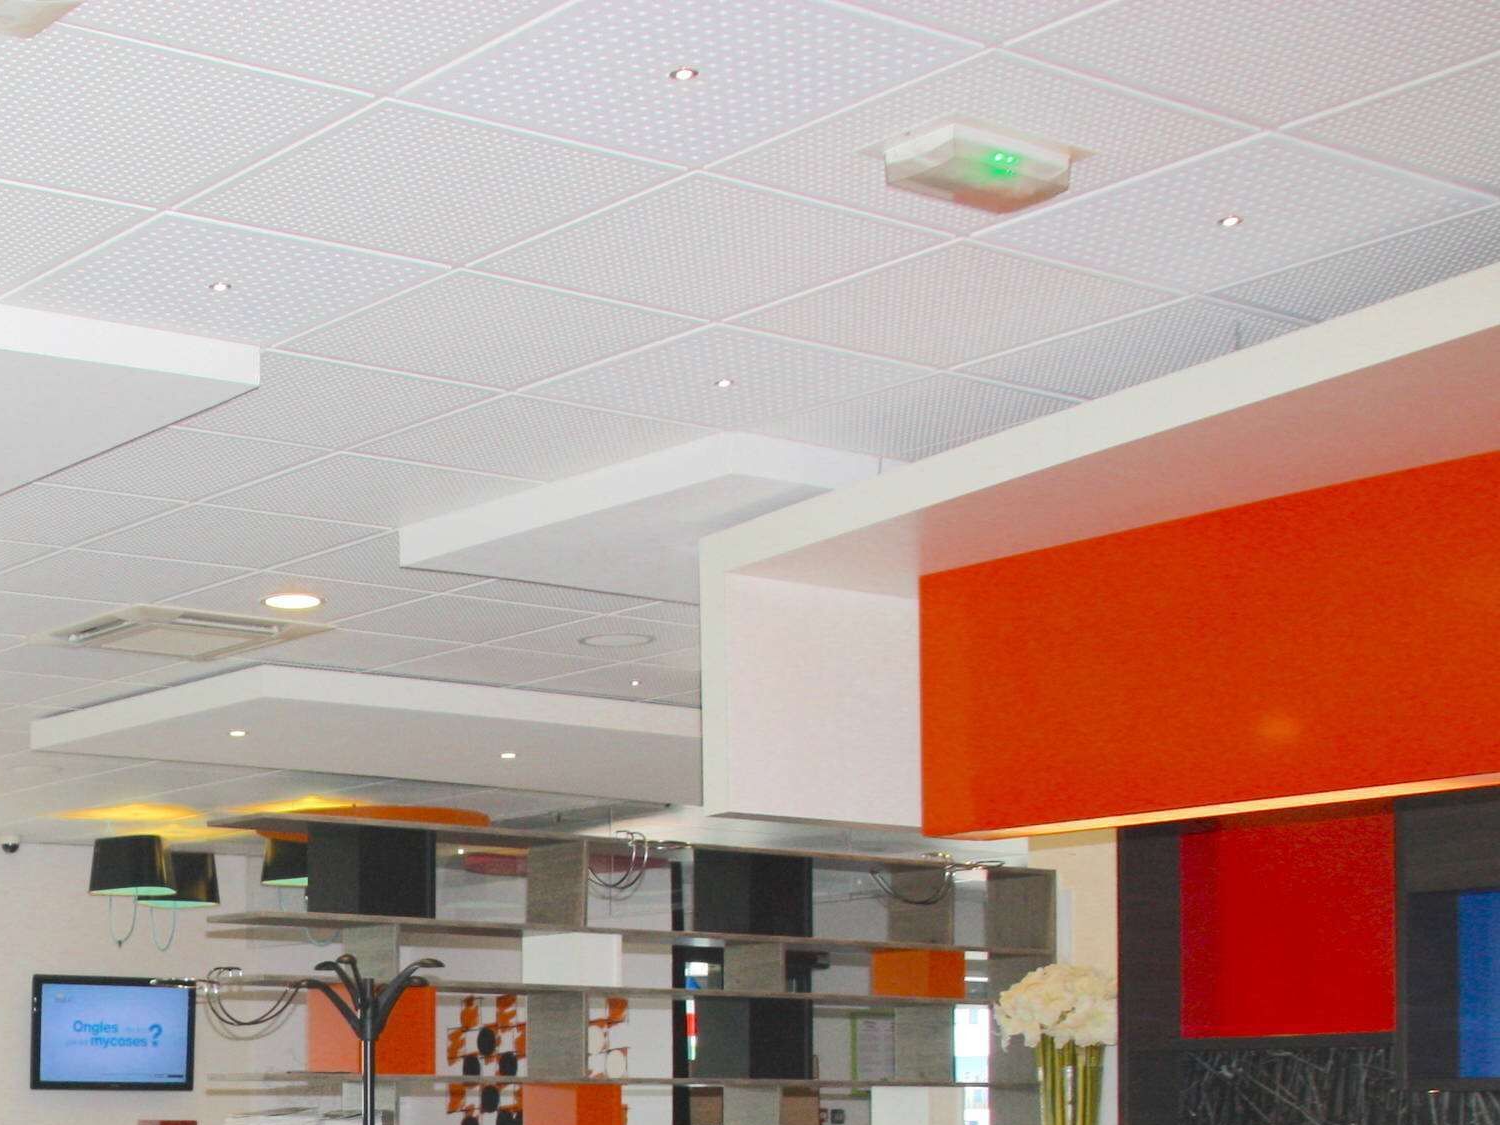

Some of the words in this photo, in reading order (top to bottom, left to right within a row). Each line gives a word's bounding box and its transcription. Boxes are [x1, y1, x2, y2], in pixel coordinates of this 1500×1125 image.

[73, 1019, 118, 1035] Ongles
[90, 1035, 149, 1049] mycoses
[148, 1023, 163, 1047] ?
